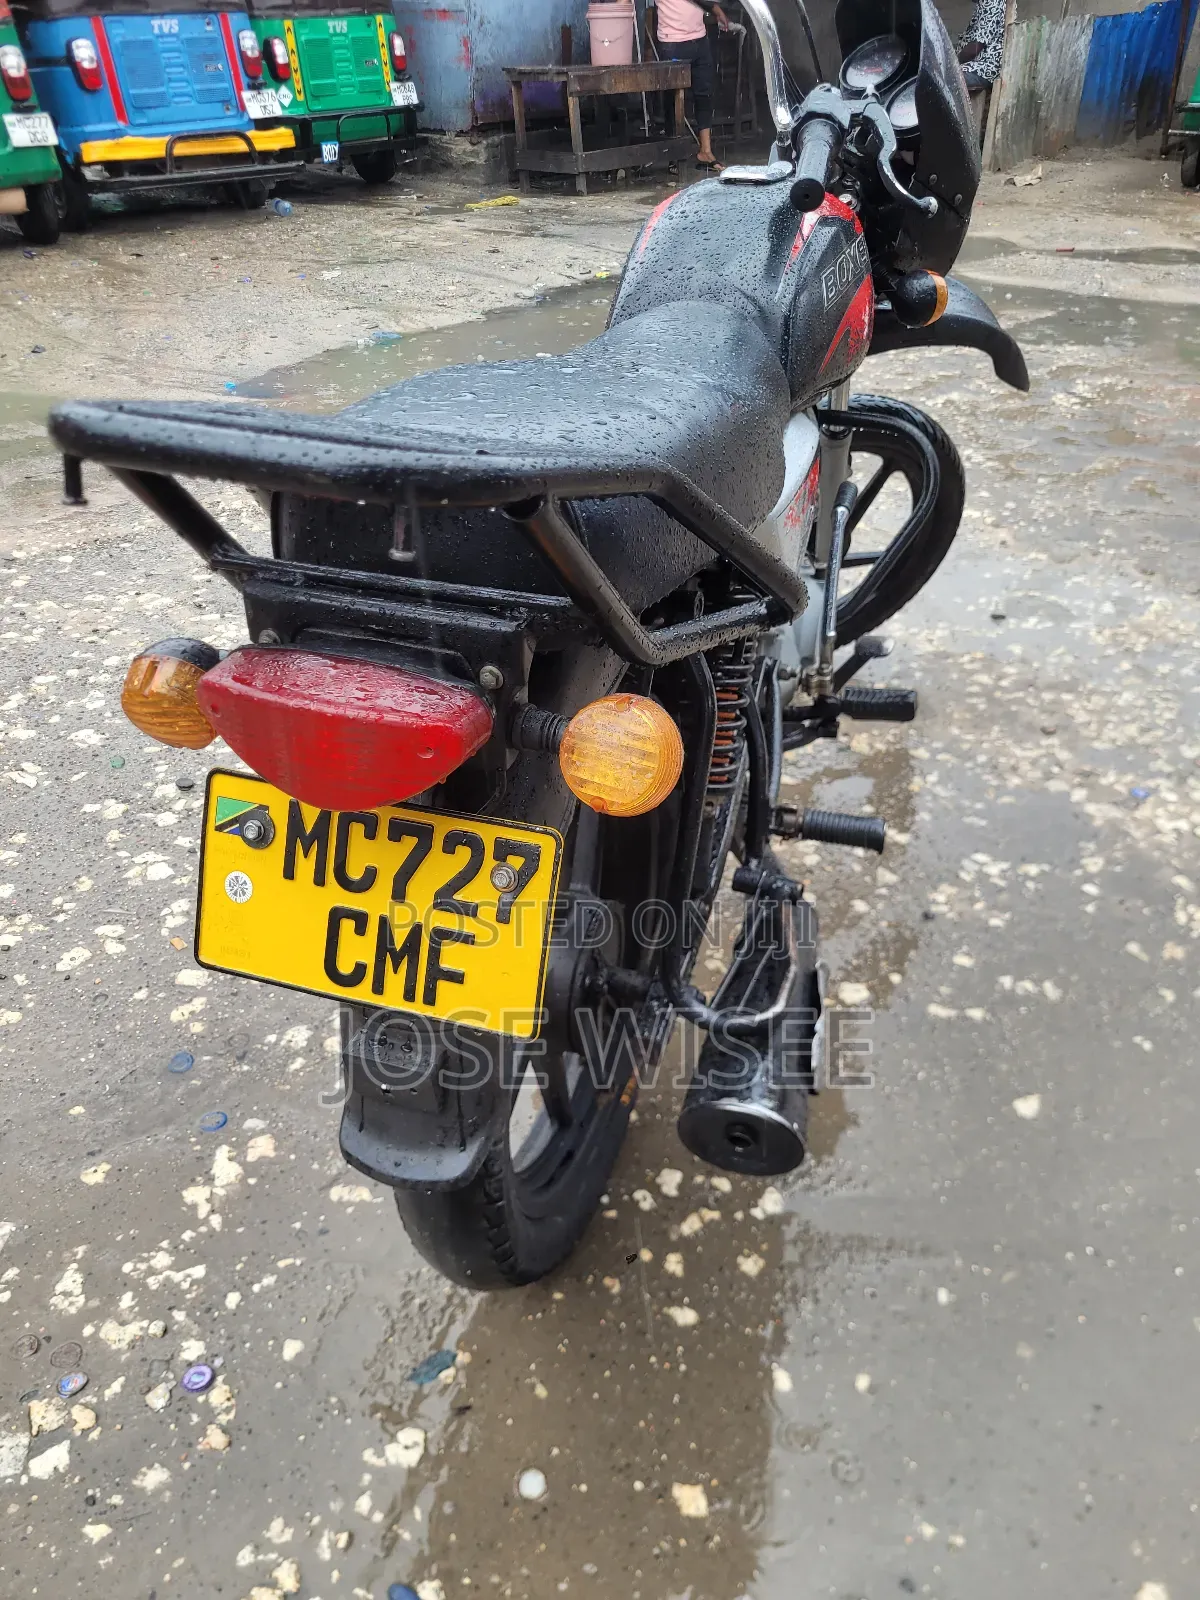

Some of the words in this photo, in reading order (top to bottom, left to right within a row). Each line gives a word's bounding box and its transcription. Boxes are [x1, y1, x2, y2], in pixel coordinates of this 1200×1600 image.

[151, 19, 179, 33] TVS
[328, 20, 347, 33] TVS
[821, 232, 869, 308] BOXE
[283, 798, 542, 924] MC727
[324, 905, 476, 1007] CMF
